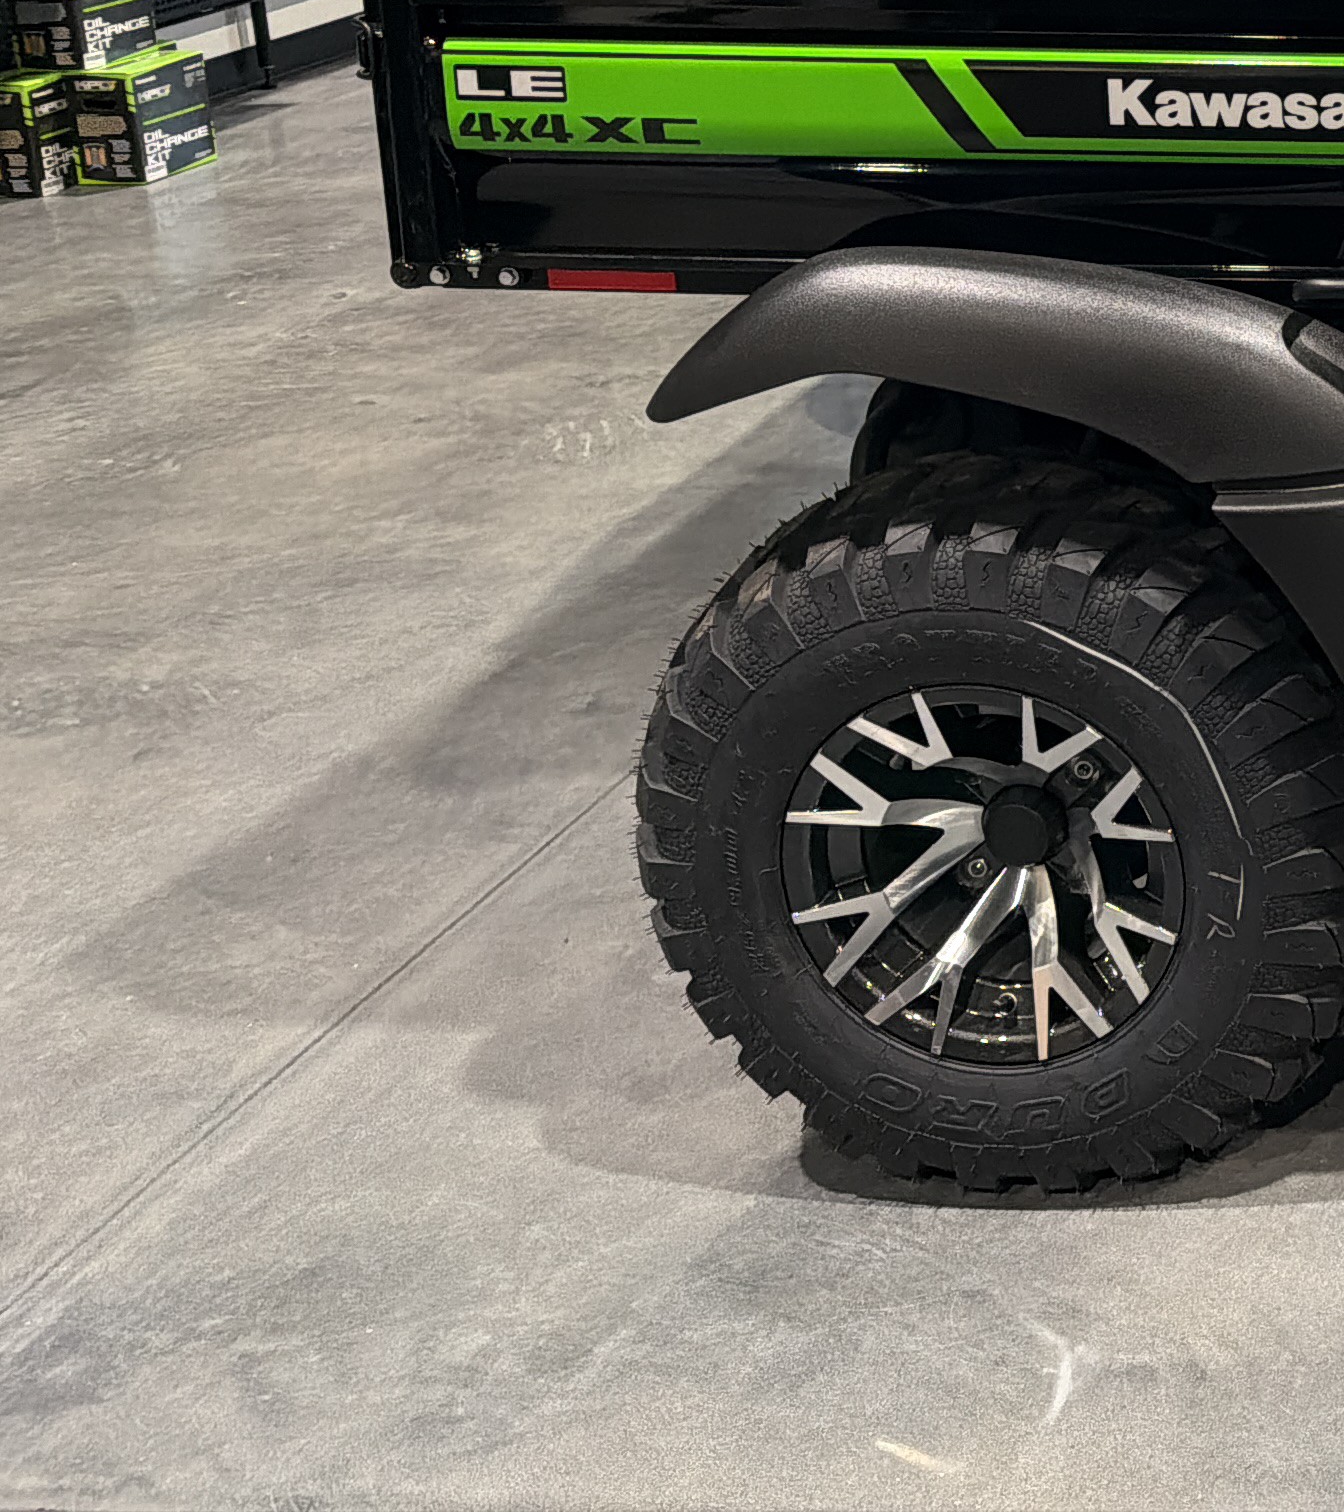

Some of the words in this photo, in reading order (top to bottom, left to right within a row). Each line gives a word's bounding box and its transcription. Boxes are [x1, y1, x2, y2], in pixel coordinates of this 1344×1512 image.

[83, 16, 111, 32] OIL
[84, 15, 151, 43] CHANGE
[87, 37, 114, 54] KIT
[455, 69, 566, 99] LE
[143, 128, 171, 145] OIL
[145, 125, 210, 156] CHANGE
[41, 141, 68, 158] OIL
[147, 148, 173, 167] KIT
